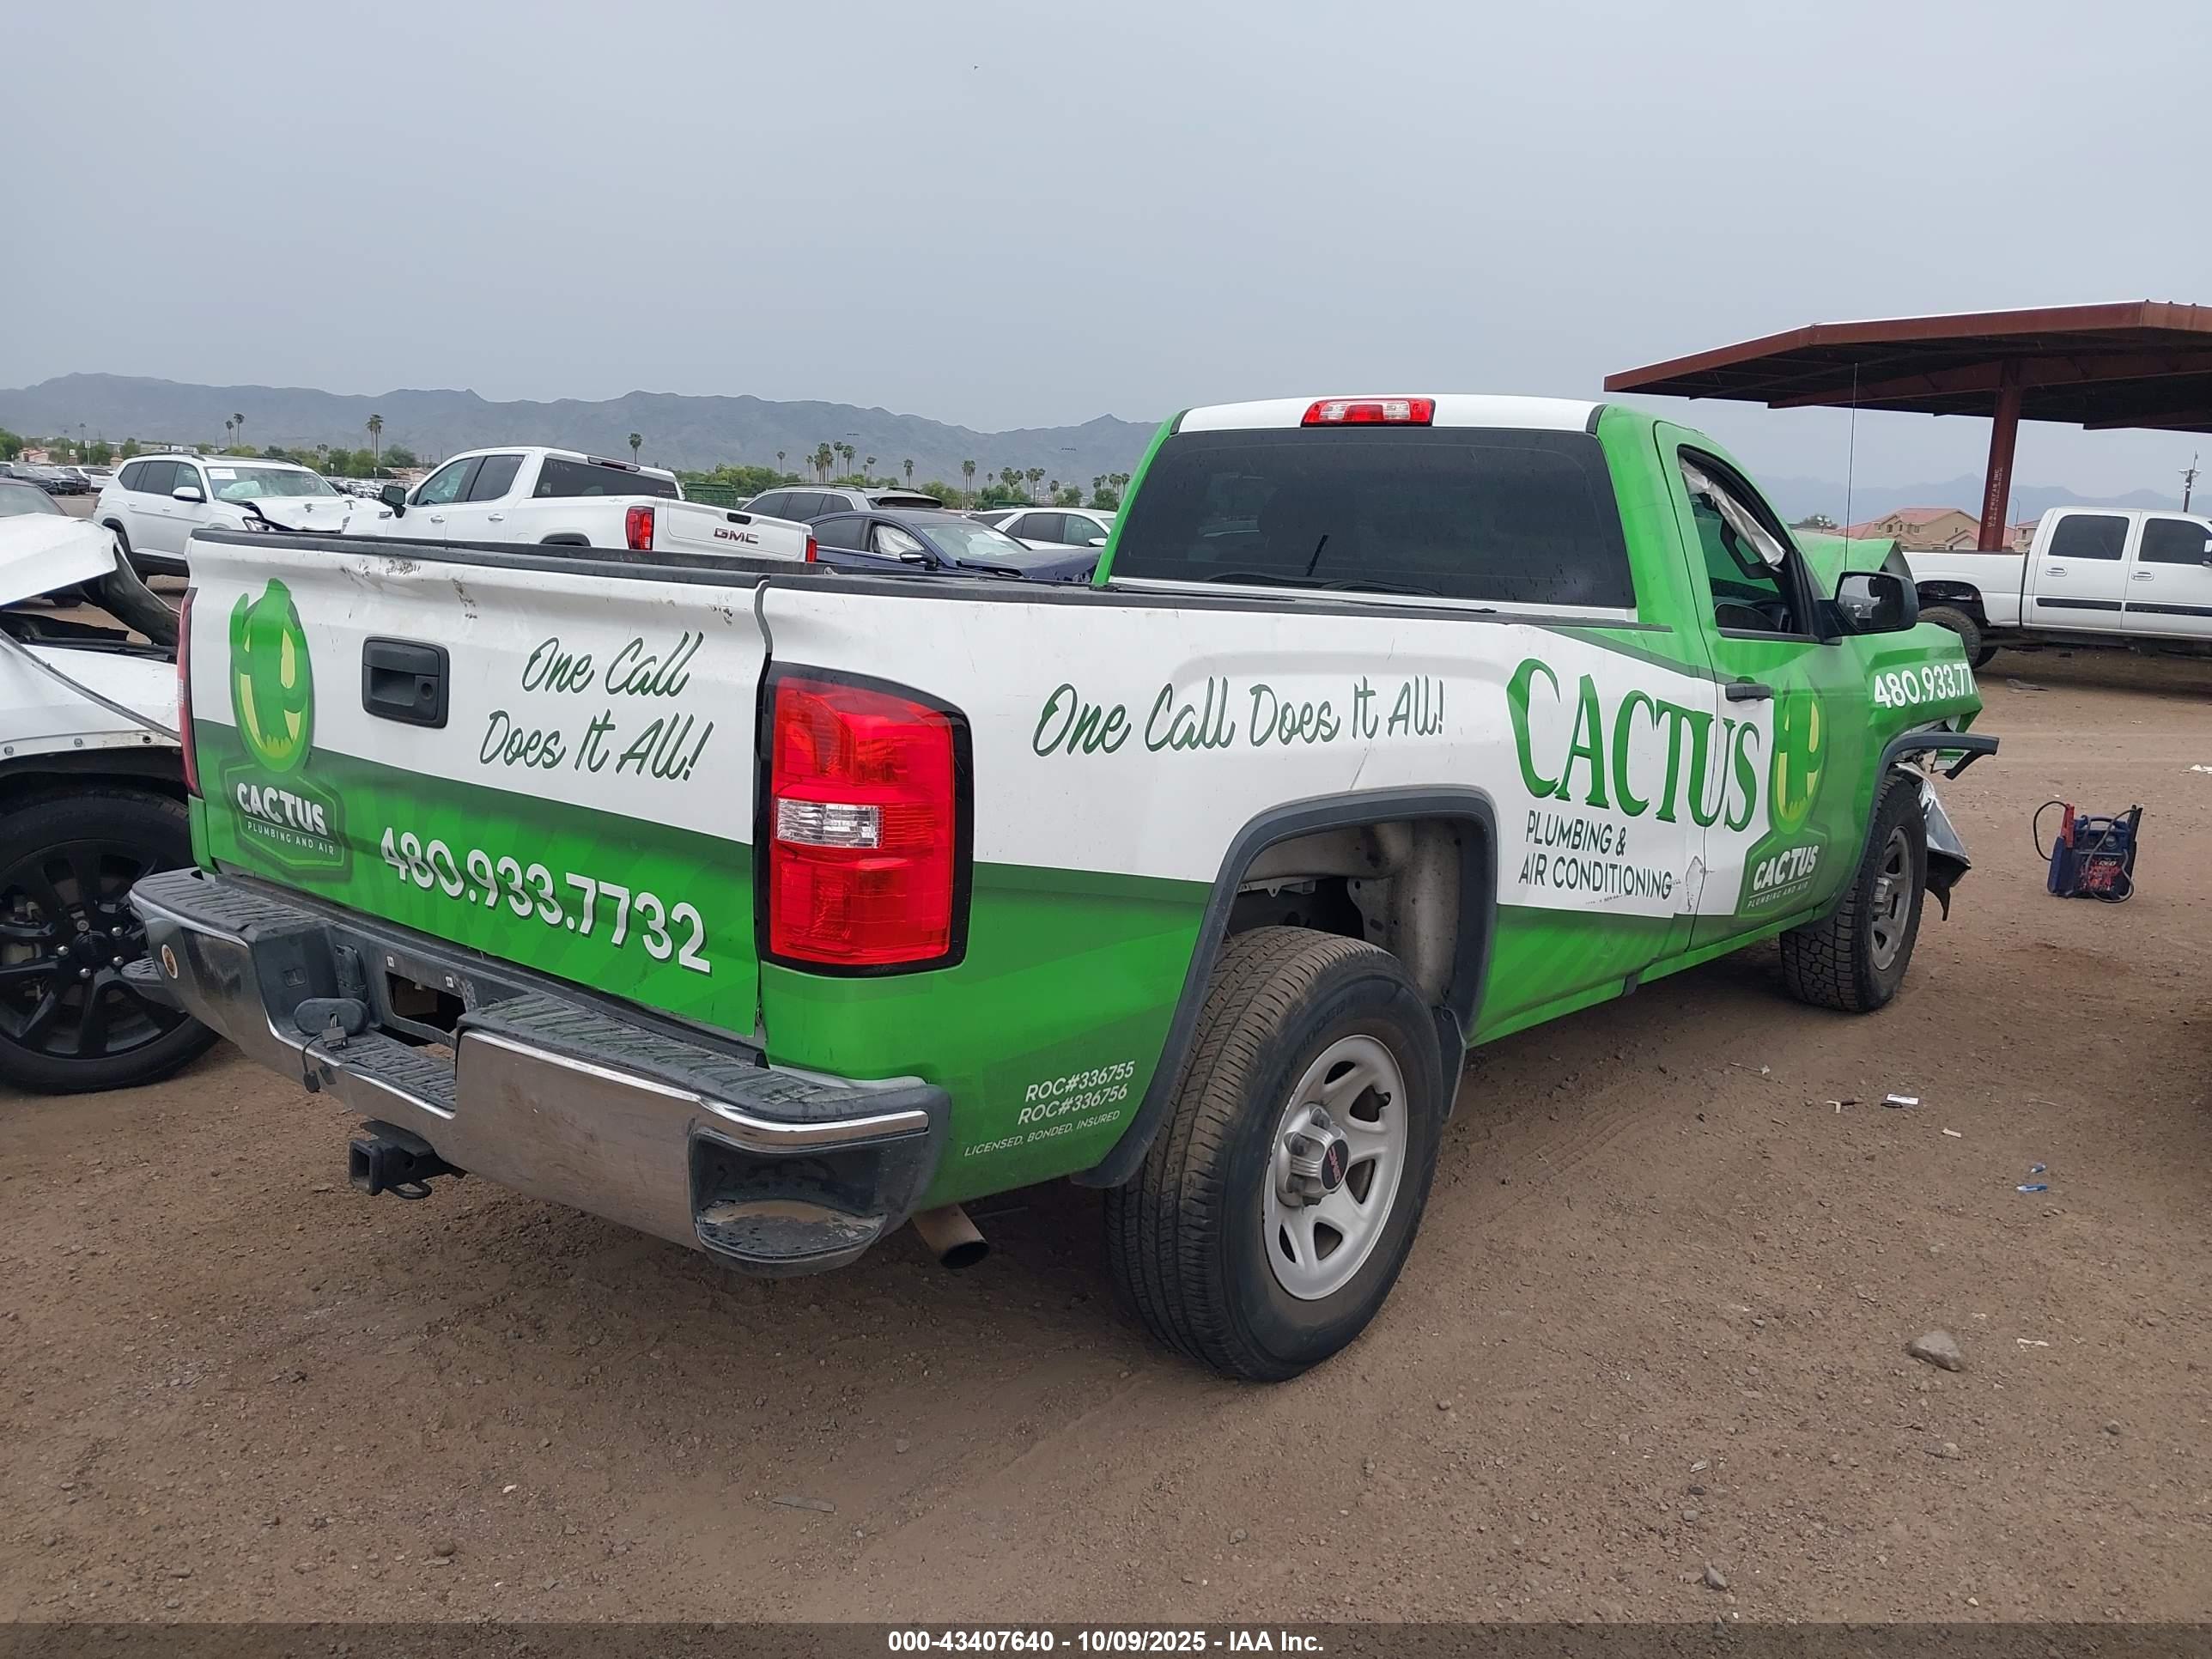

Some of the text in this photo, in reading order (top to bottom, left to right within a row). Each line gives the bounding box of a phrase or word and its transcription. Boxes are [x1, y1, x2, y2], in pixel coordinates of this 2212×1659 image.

[714, 527, 759, 544] GMC
[522, 631, 704, 697] One Call
[1031, 674, 1444, 757] One Call Does It All!
[479, 708, 714, 782] Does It All!
[1506, 658, 1760, 832] CACTUS
[236, 782, 329, 836] CACTUS
[247, 821, 334, 856] PLUMBING AND AIR
[1524, 810, 1627, 857] PLUMBING &
[1518, 852, 1674, 901] AIR CONDITIONING
[1753, 845, 1820, 891] CACTUS
[380, 827, 711, 974] 480.933.7732
[1017, 1084, 1128, 1125] ROC#336756
[1024, 1060, 1136, 1103] ROC#336755
[964, 1135, 1024, 1157] LICENSED,
[1076, 1110, 1121, 1130] INSURED
